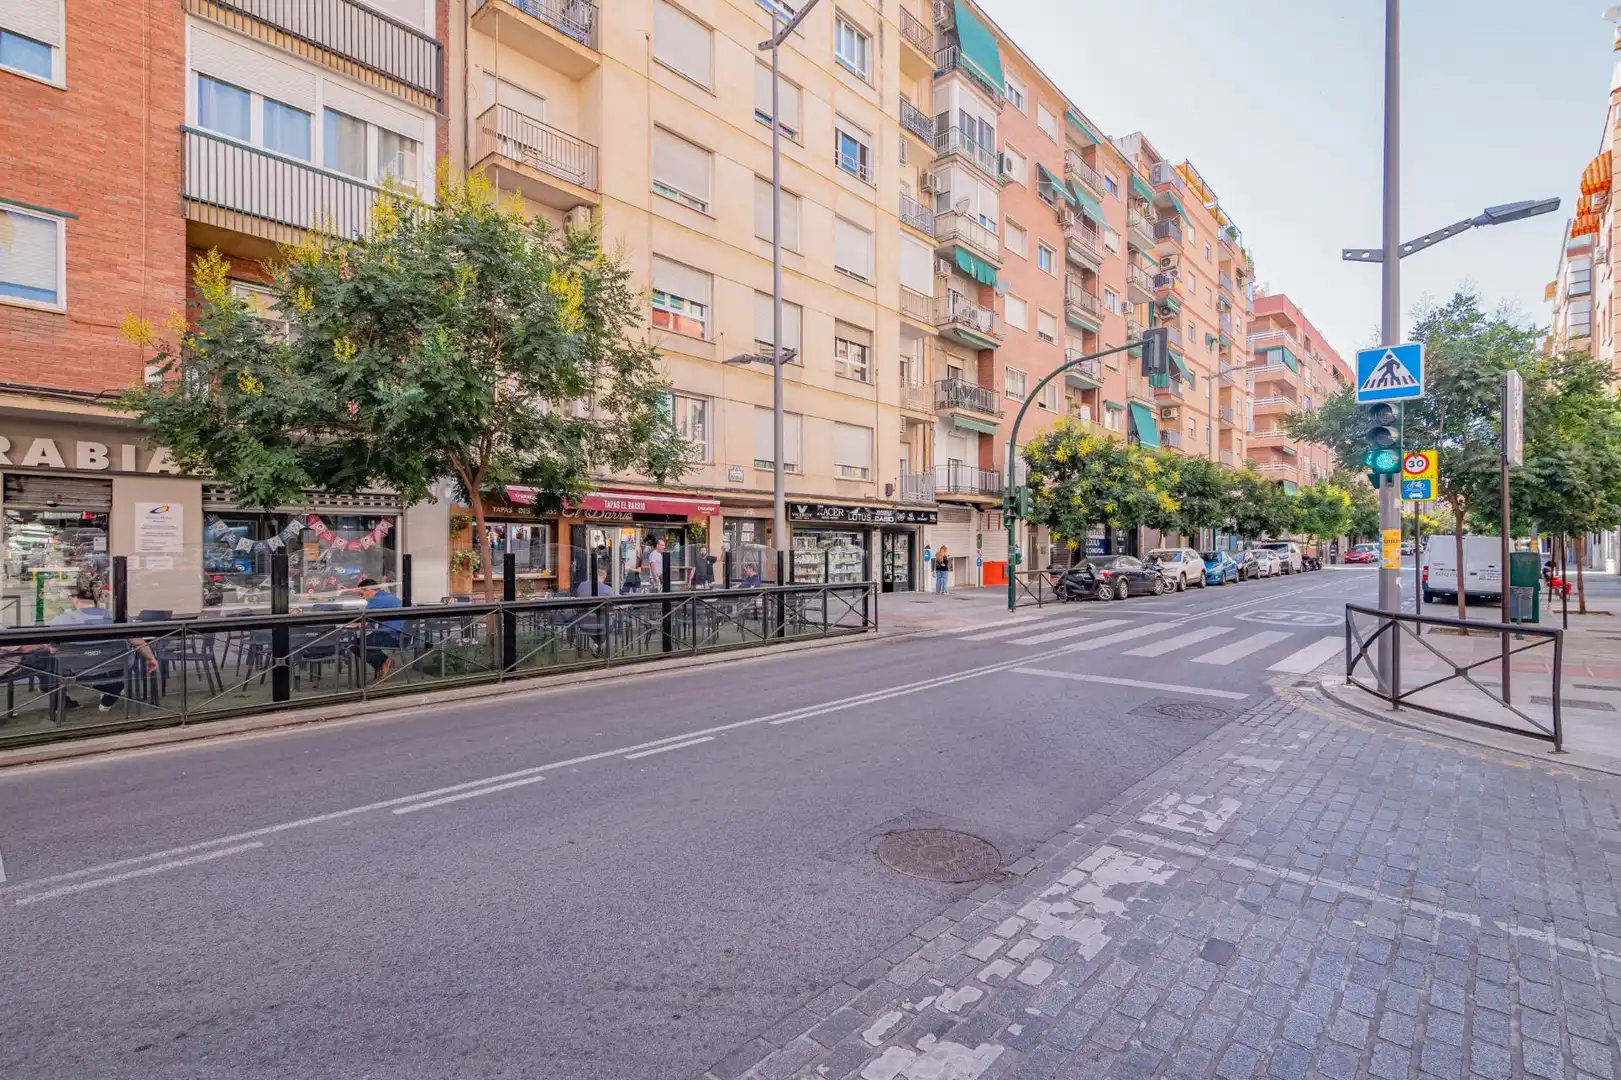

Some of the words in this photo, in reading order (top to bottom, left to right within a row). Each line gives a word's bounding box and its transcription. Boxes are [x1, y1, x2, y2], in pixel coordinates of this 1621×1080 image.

[1408, 460, 1424, 468] 30
[604, 500, 620, 508] TAPAS
[628, 502, 645, 510] BARRIO
[492, 506, 513, 514] TAPAS
[848, 513, 871, 521] LOTUS
